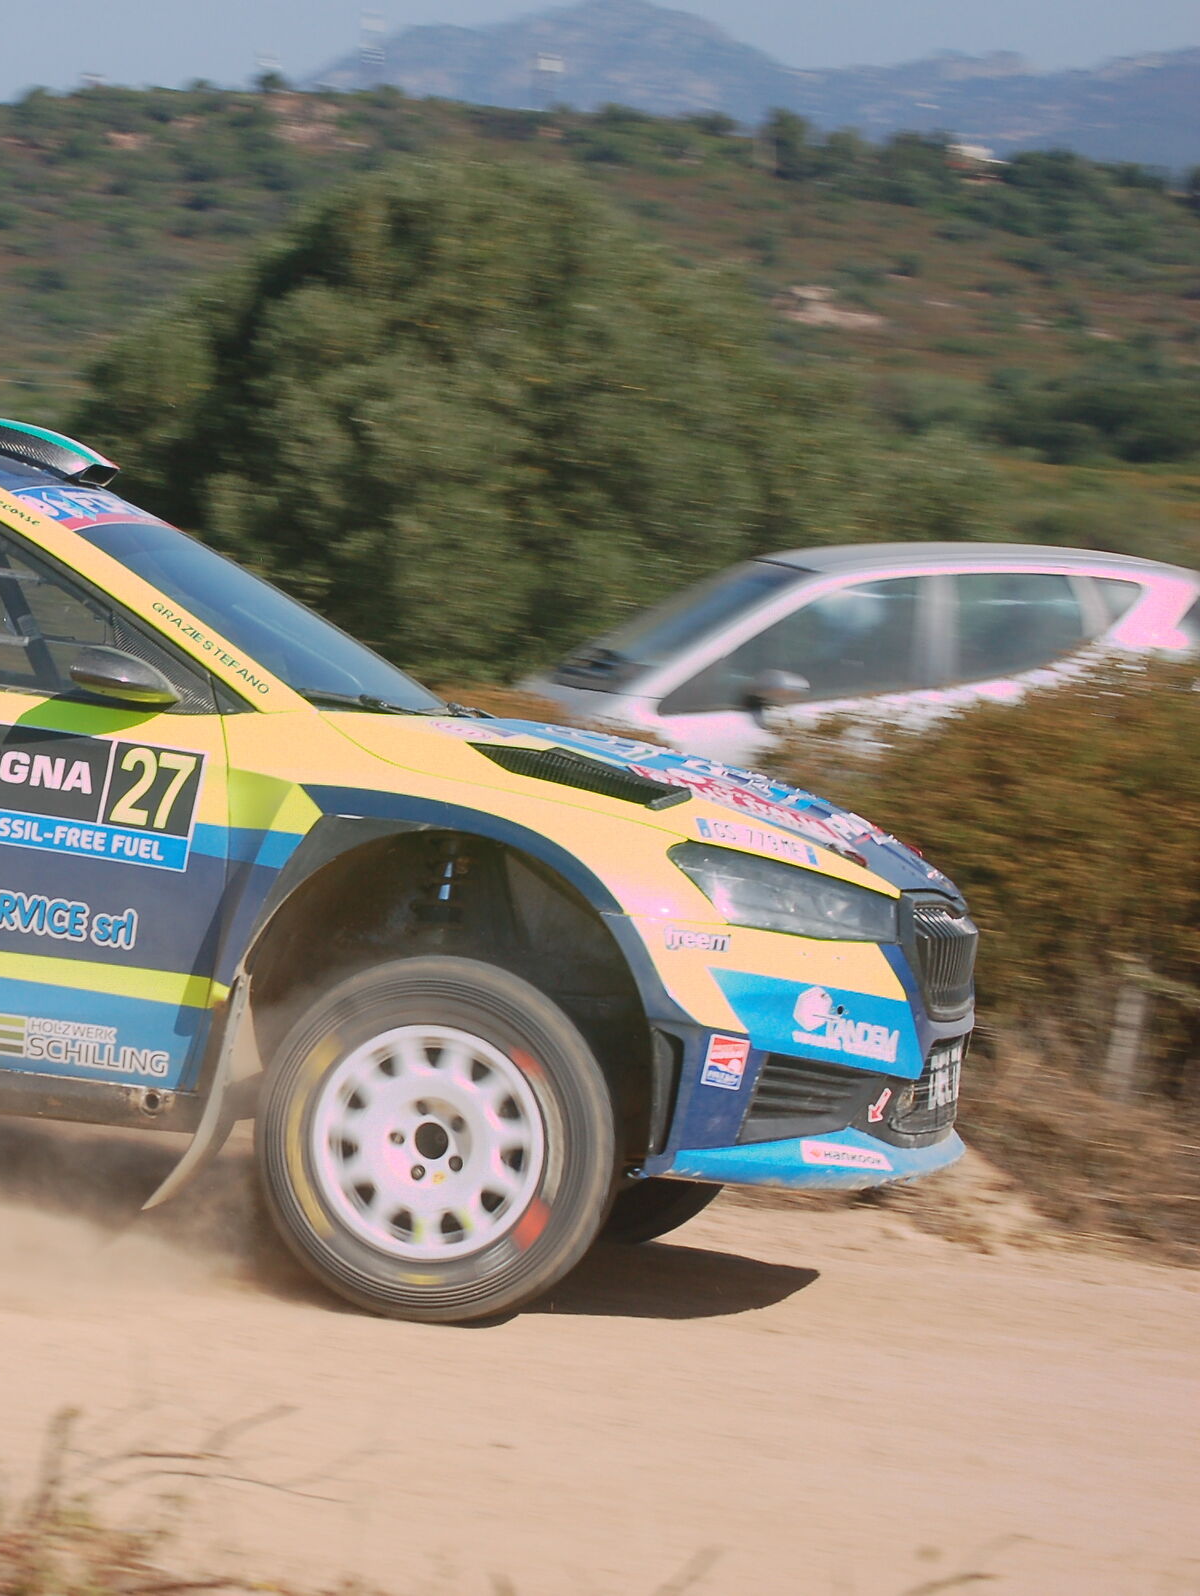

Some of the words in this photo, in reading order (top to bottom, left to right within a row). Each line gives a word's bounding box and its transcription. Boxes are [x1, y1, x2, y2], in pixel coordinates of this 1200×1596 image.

[108, 746, 198, 829] 27
[111, 835, 165, 861] FUEL
[93, 911, 135, 947] srl
[30, 1019, 115, 1042] HOLZWERK
[28, 1036, 169, 1075] SCHILLING
